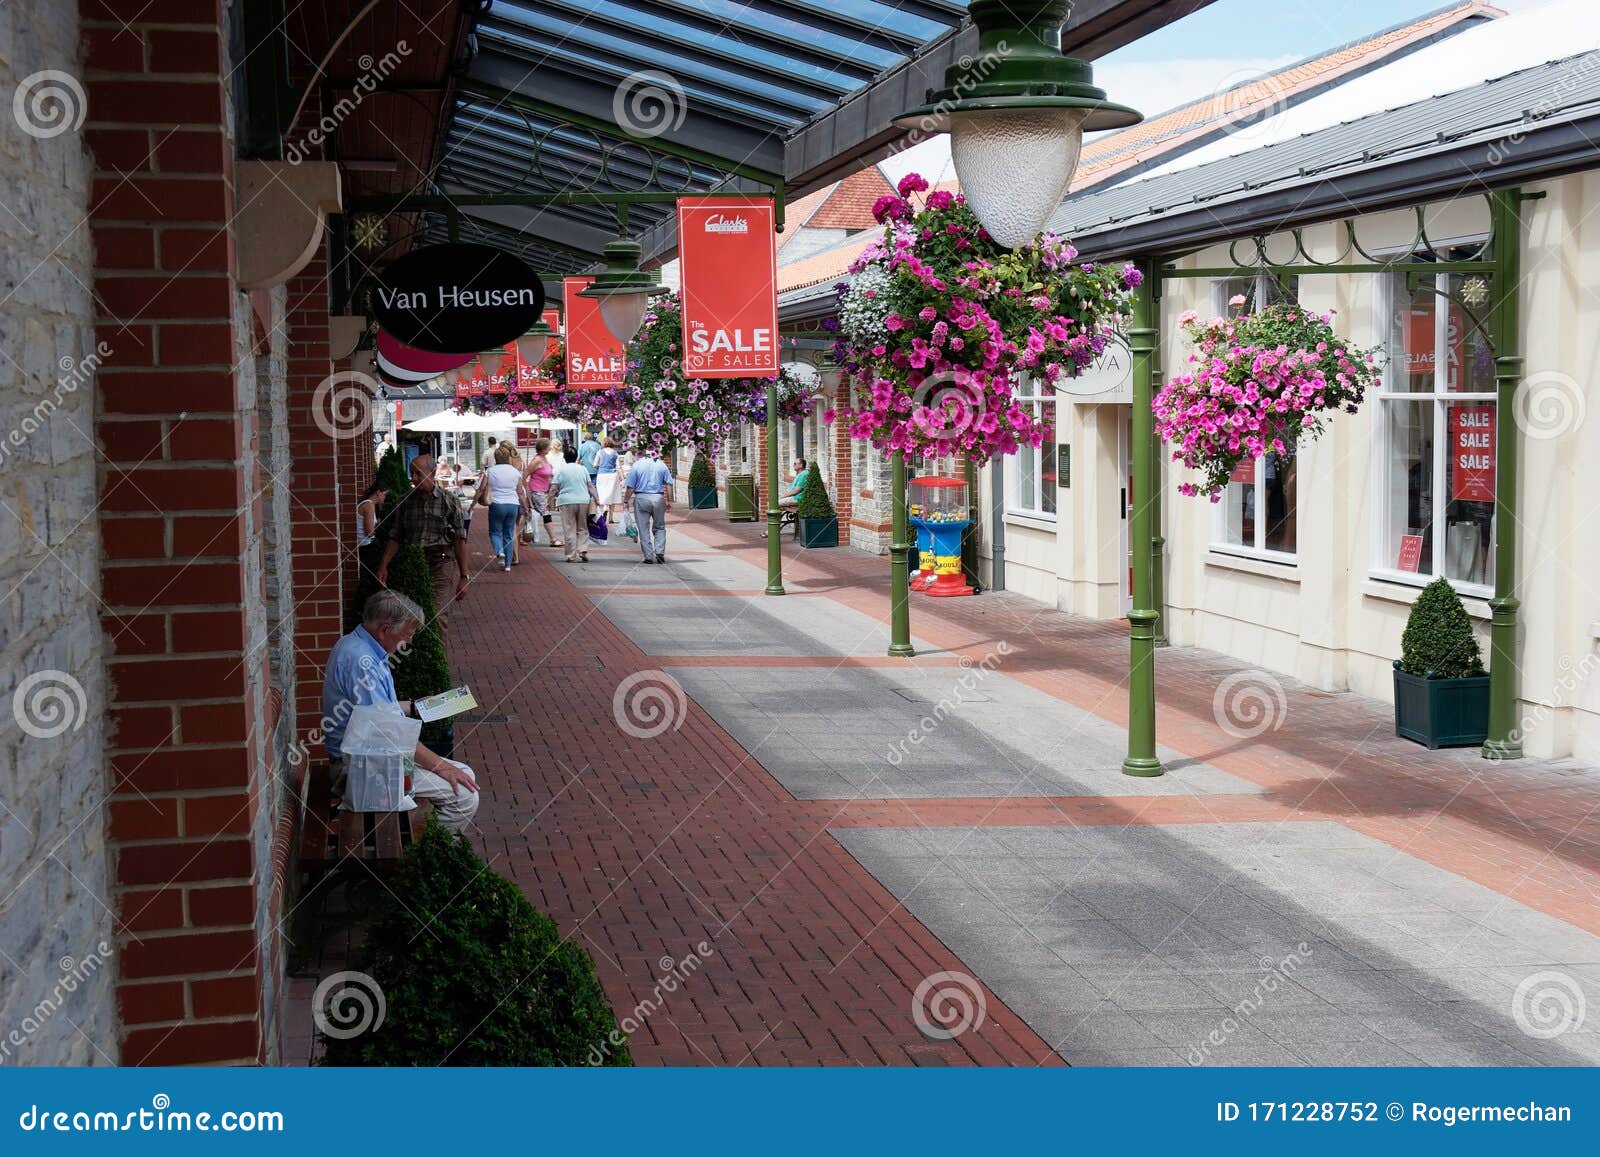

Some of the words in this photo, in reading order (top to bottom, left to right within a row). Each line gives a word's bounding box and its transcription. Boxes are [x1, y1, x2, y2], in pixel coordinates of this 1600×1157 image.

[705, 214, 748, 229] Clarks
[378, 287, 427, 309] Van
[439, 286, 534, 308] Heusen
[690, 321, 705, 329] The
[692, 329, 771, 352] SALE
[572, 357, 622, 372] SALE
[693, 355, 714, 367] OF
[724, 354, 772, 366] SALES
[1460, 413, 1489, 427] SALE
[1460, 433, 1489, 448] SALE
[1460, 454, 1489, 470] SALE
